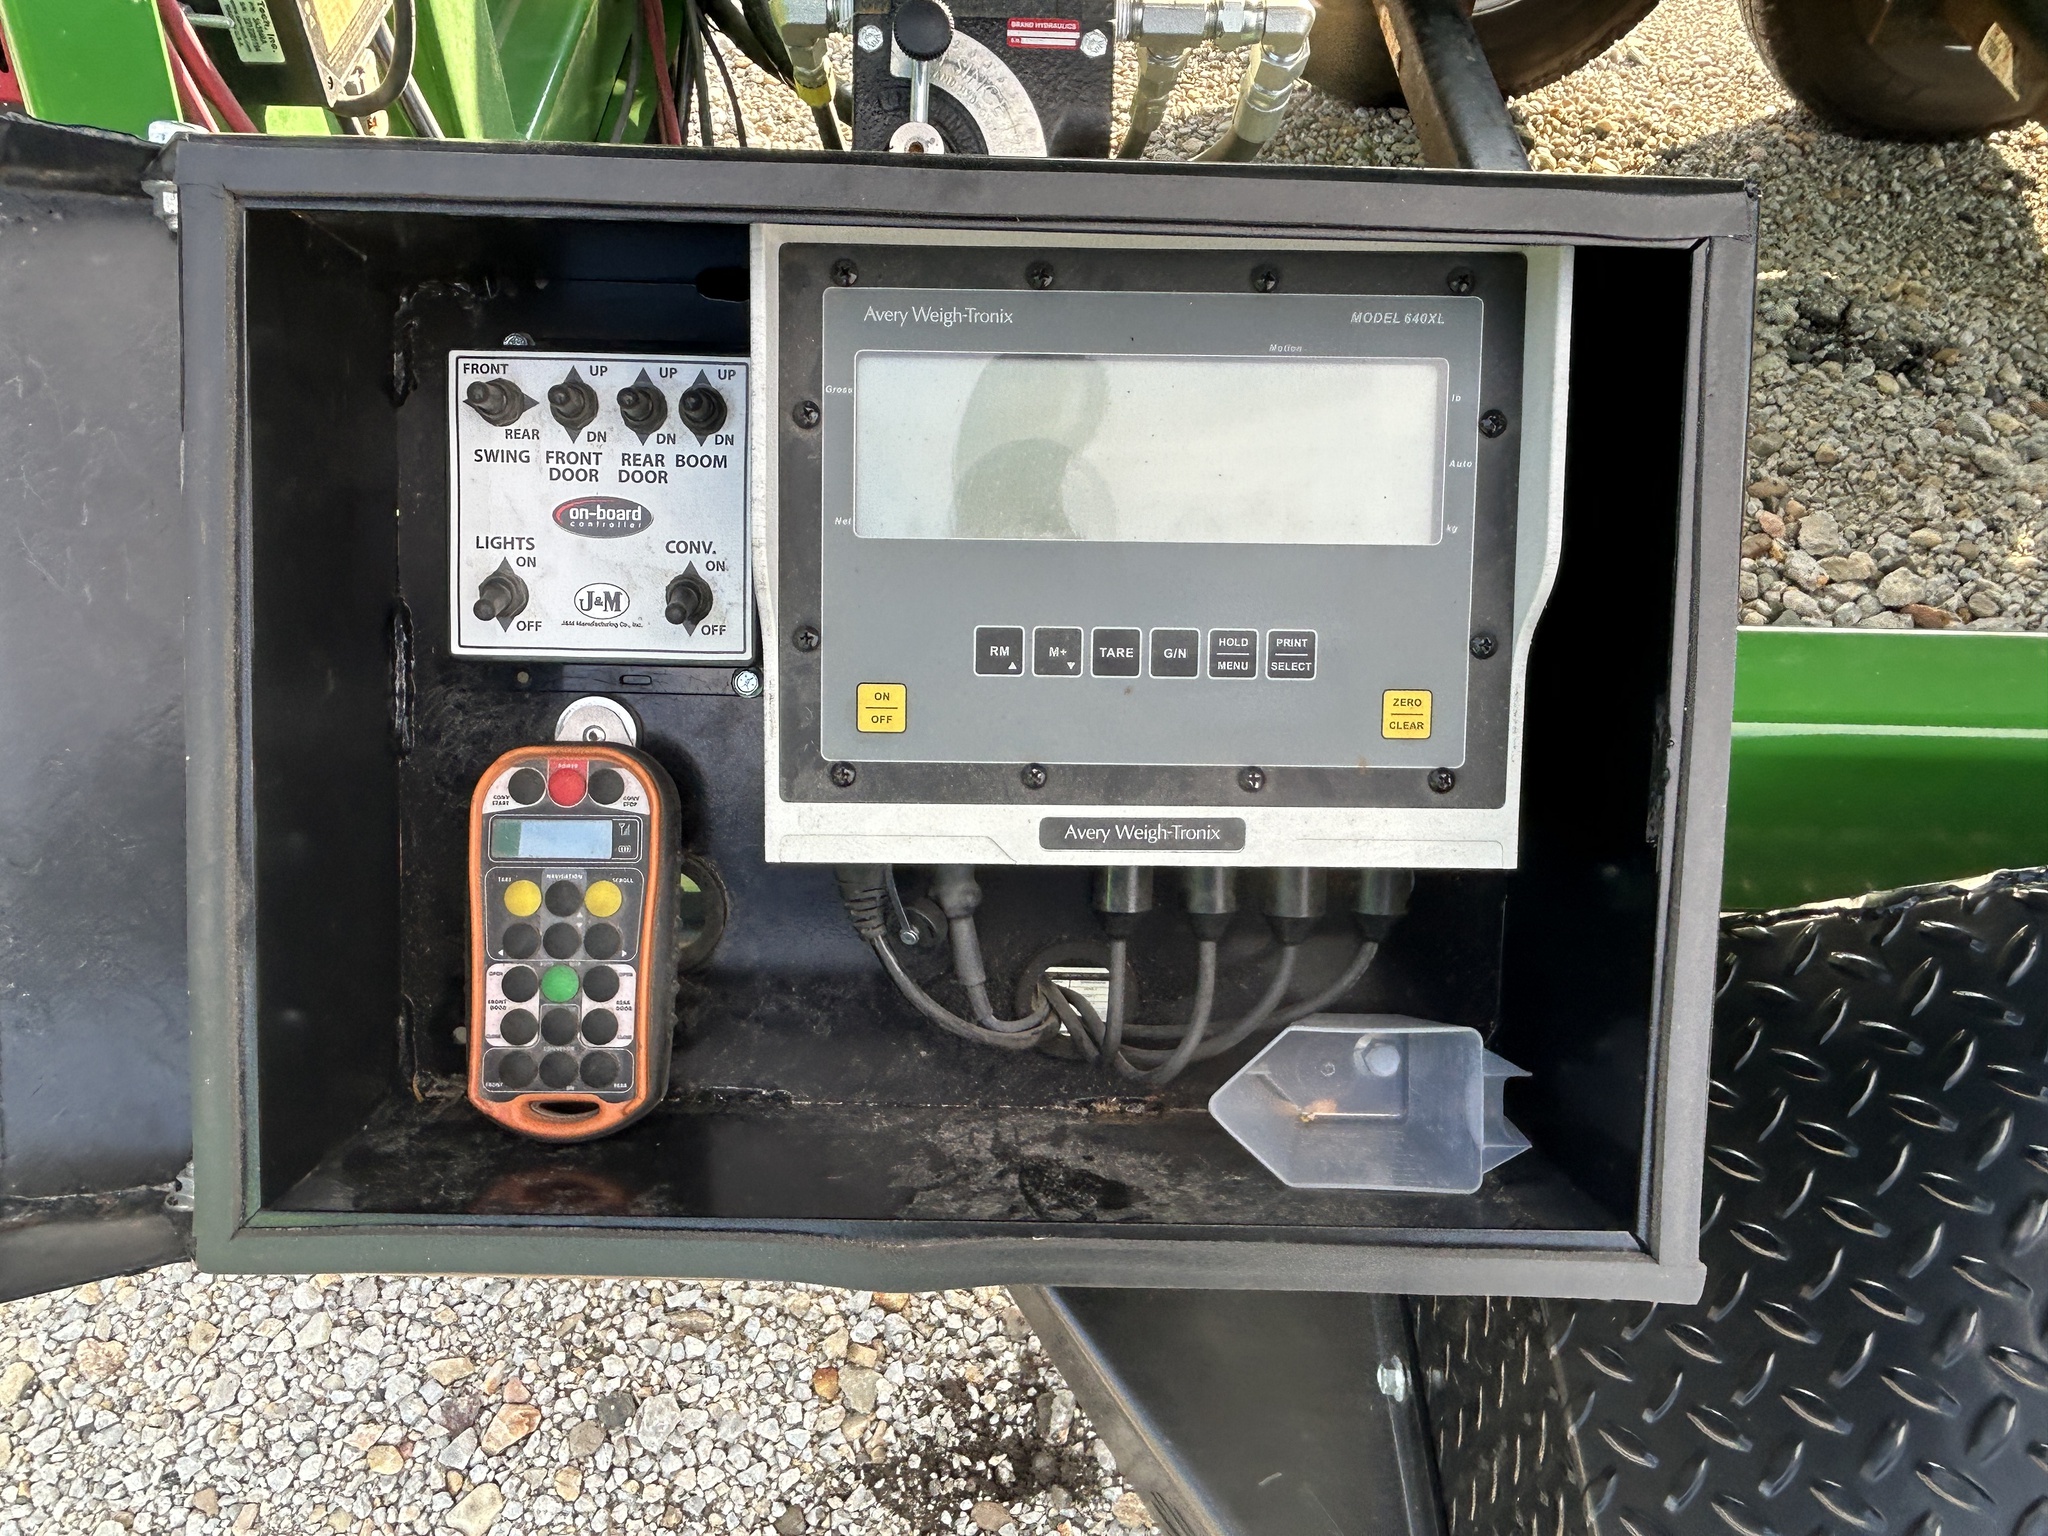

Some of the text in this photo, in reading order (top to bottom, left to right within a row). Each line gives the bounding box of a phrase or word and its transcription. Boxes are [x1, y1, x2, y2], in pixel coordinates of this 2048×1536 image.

[864, 306, 1013, 327] Avery Weigh-Tronix
[1350, 312, 1445, 324] MODEL 640XL
[1269, 344, 1303, 352] Motion
[463, 363, 509, 375] FRONT
[589, 365, 608, 377] UP
[659, 367, 678, 379] UP
[718, 369, 737, 380] UP
[505, 429, 540, 441] REAR
[586, 431, 607, 442] DN
[656, 433, 676, 445] DN
[715, 435, 735, 446] DN
[474, 449, 531, 463] SWING
[545, 451, 603, 466] FRONT
[621, 453, 665, 467] REAR
[675, 454, 728, 468] BOOM
[1448, 460, 1473, 468] Auto
[549, 468, 599, 482] DOOR
[618, 470, 669, 484] DOOR
[569, 504, 642, 521] on-board
[834, 517, 852, 525] Net
[476, 536, 535, 551] LIGHTS
[665, 540, 717, 555] CONV.
[516, 556, 537, 568] ON
[705, 560, 726, 572] ON
[579, 590, 623, 612] J&M
[516, 620, 543, 632] OFF
[701, 625, 726, 636] OFF
[1218, 638, 1249, 647] HOLD
[1276, 638, 1308, 648] PRINT
[990, 646, 1010, 656] RM
[1049, 647, 1067, 657] M+
[1099, 647, 1134, 658] TARE
[1163, 648, 1187, 659] G/N
[1217, 661, 1249, 671] MENU
[1271, 662, 1312, 671] SELECT
[874, 692, 890, 701] ON
[1392, 698, 1422, 707] ZERO
[871, 715, 893, 724] OFF
[1389, 721, 1424, 730] CLEAR
[1064, 824, 1221, 843] Avery Weigh-Tronix
